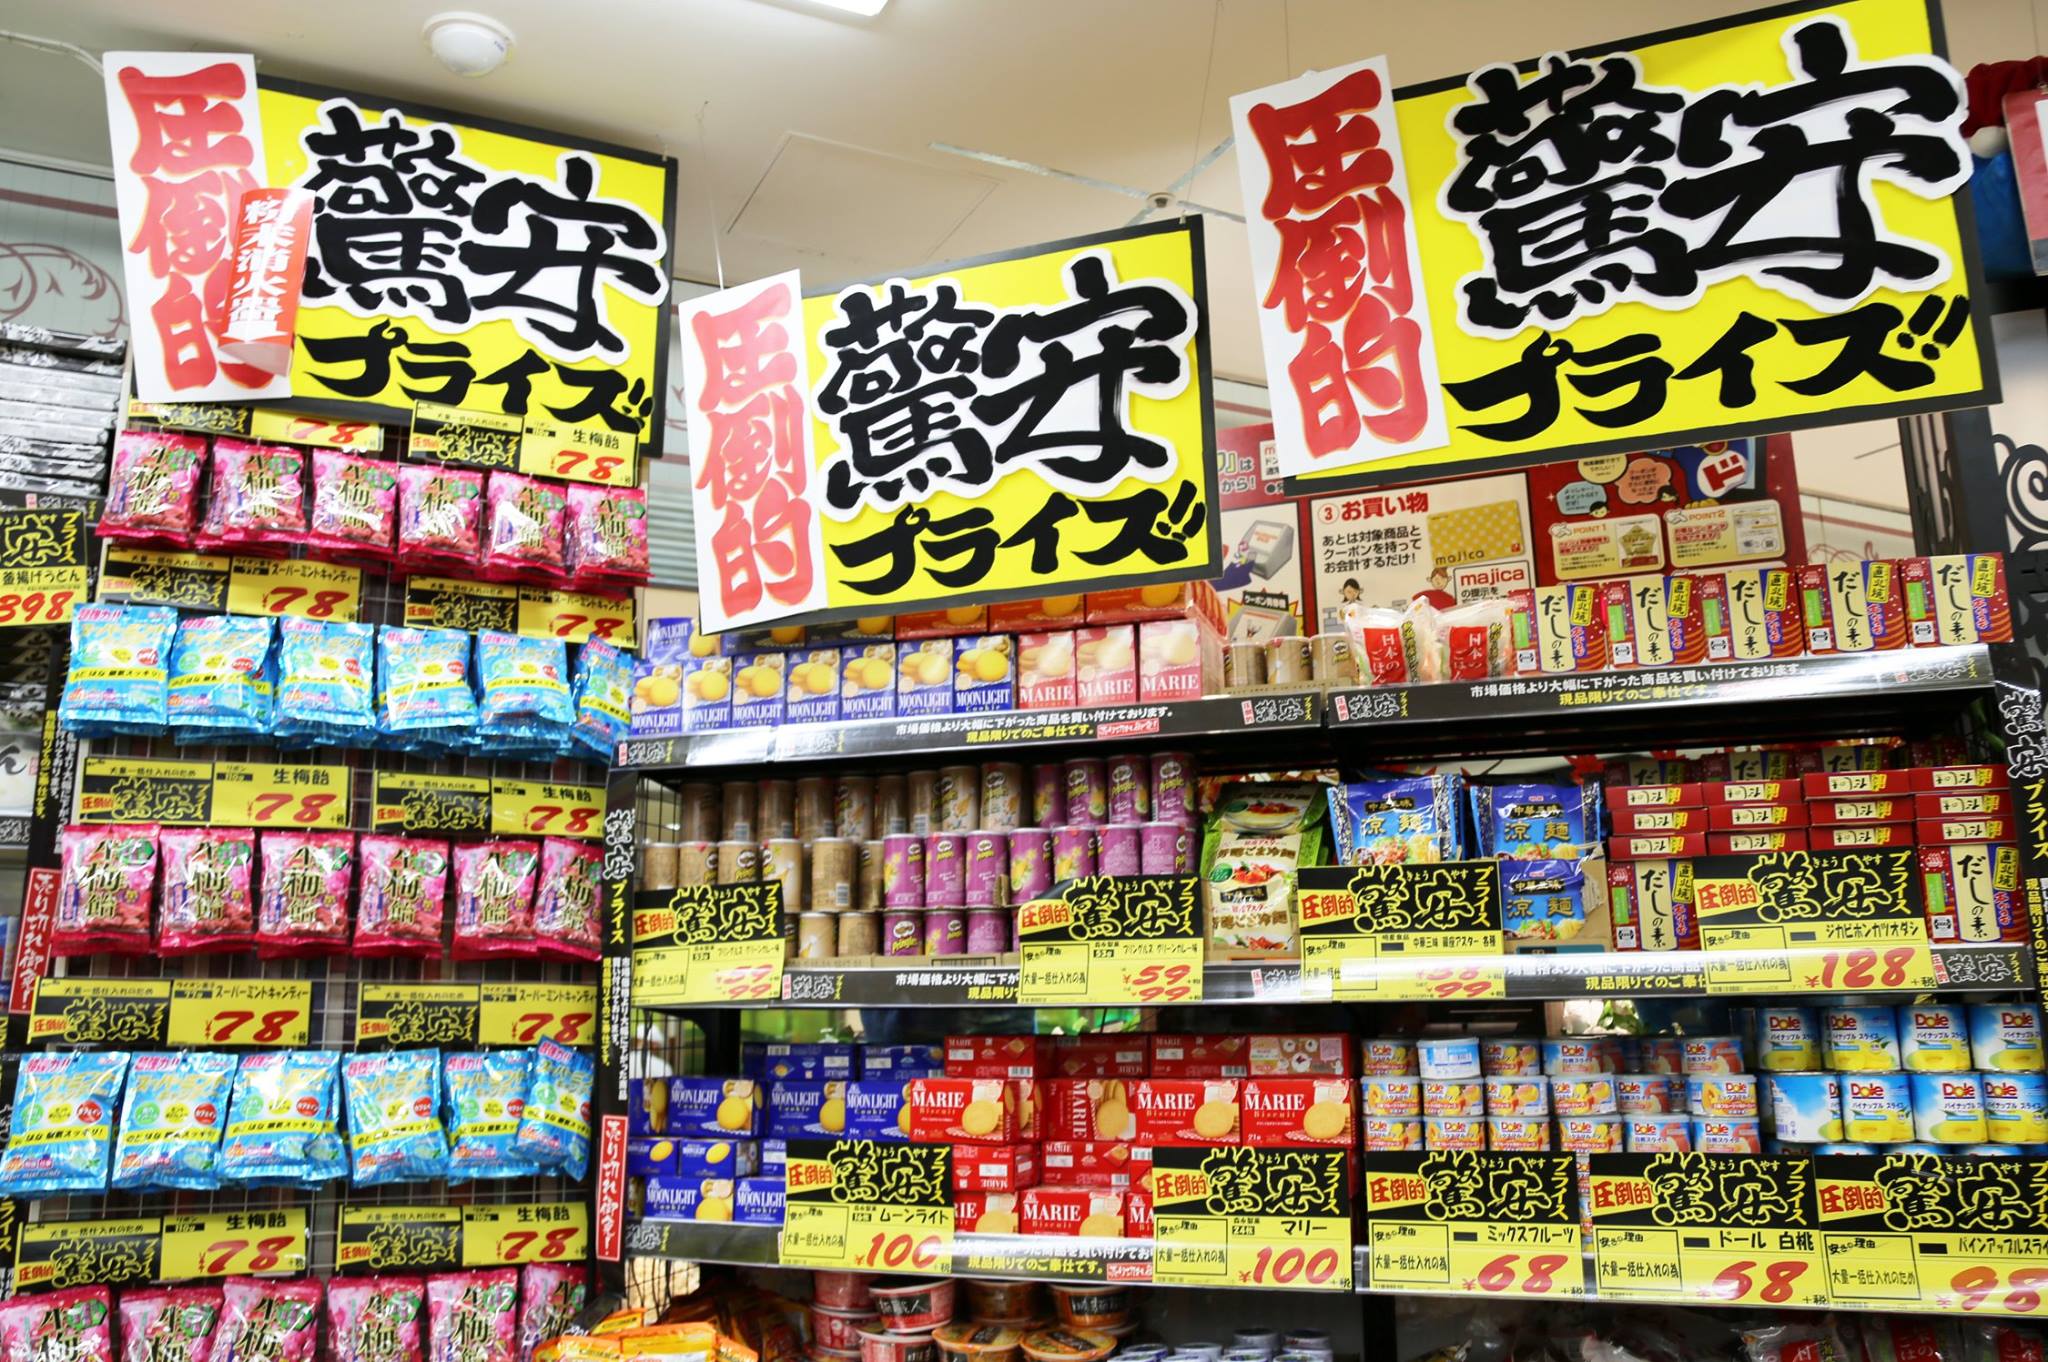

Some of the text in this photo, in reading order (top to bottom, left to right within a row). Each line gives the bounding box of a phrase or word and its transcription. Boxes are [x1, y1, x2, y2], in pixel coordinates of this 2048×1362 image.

[1450, 23, 1960, 328] 驚安
[302, 106, 664, 352] 驚安
[1248, 70, 1427, 457] 圧倒的
[818, 256, 1187, 508] 驚安
[695, 282, 814, 617] 圧倒的
[1322, 525, 1422, 546] あとは対象商品と
[1322, 538, 1422, 560] クーポンを持って
[1324, 553, 1416, 573] お会計するだけ!
[2, 568, 81, 586] 釜揚げうどん
[1460, 566, 1525, 588] majica
[1833, 570, 1864, 648] だしの素
[1937, 563, 1968, 642] だしの素
[1636, 586, 1664, 661] だしの素
[1732, 579, 1762, 656] だしの素
[1541, 594, 1567, 669] だしの素
[1019, 685, 1074, 703] MARIE
[1080, 678, 1133, 697] MARIE
[1142, 674, 1199, 691] MARIE
[898, 692, 950, 709] MOONLIGHT
[956, 688, 1010, 707] MOONLIGHT
[272, 767, 330, 785] 生梅飴
[1888, 849, 1913, 915] プライス
[1176, 876, 1198, 936] プライス
[1302, 893, 1355, 920] 圧倒的
[1471, 866, 1494, 928] プライス
[1699, 882, 1757, 911] 圧倒的
[1958, 853, 1990, 939] だしの素
[609, 879, 630, 945] プライス
[764, 883, 780, 936] プライス
[1021, 904, 1070, 928] 圧倒的
[1641, 868, 1669, 948] だしの素
[1826, 922, 1918, 940] ジカビホンガツオダシ
[1805, 948, 1916, 989] ¥128
[1914, 1013, 1949, 1028] Dole
[671, 1089, 719, 1106] MOONLIGHT
[770, 1089, 820, 1106] MOONLIGHT
[847, 1091, 899, 1109] MOONLIGHT
[912, 1091, 965, 1109] MARIE
[1244, 1092, 1306, 1111] MARIE
[1850, 1082, 1885, 1098] Dole
[1942, 1083, 1976, 1098] Dole
[1137, 1093, 1196, 1111] MARIE
[788, 1163, 832, 1186] 圧倒的
[928, 1146, 950, 1204] プライス
[1155, 1172, 1208, 1199] 圧倒的
[1321, 1150, 1345, 1215] プライス
[646, 1188, 697, 1206] MOONLIGHT
[1369, 1176, 1426, 1202] 圧倒的
[1547, 1156, 1574, 1222] プライス
[1593, 1180, 1653, 1208] 圧倒的
[1785, 1159, 1810, 1226] プライス
[1819, 1184, 1885, 1214] 圧倒的
[225, 1212, 287, 1231] 生梅飴
[516, 1206, 571, 1223] 生梅飴
[879, 1208, 950, 1225] ムーンライト
[1023, 1203, 1081, 1222] MARIE
[1281, 1220, 1328, 1237] マリー
[1486, 1225, 1575, 1244] ミックスフルーツ
[1719, 1230, 1815, 1252] ドール 白桃
[1238, 1246, 1335, 1285] ¥100
[1462, 1253, 1569, 1293] ¥68
[1831, 1270, 1917, 1286] 大量一括仕入れのため
